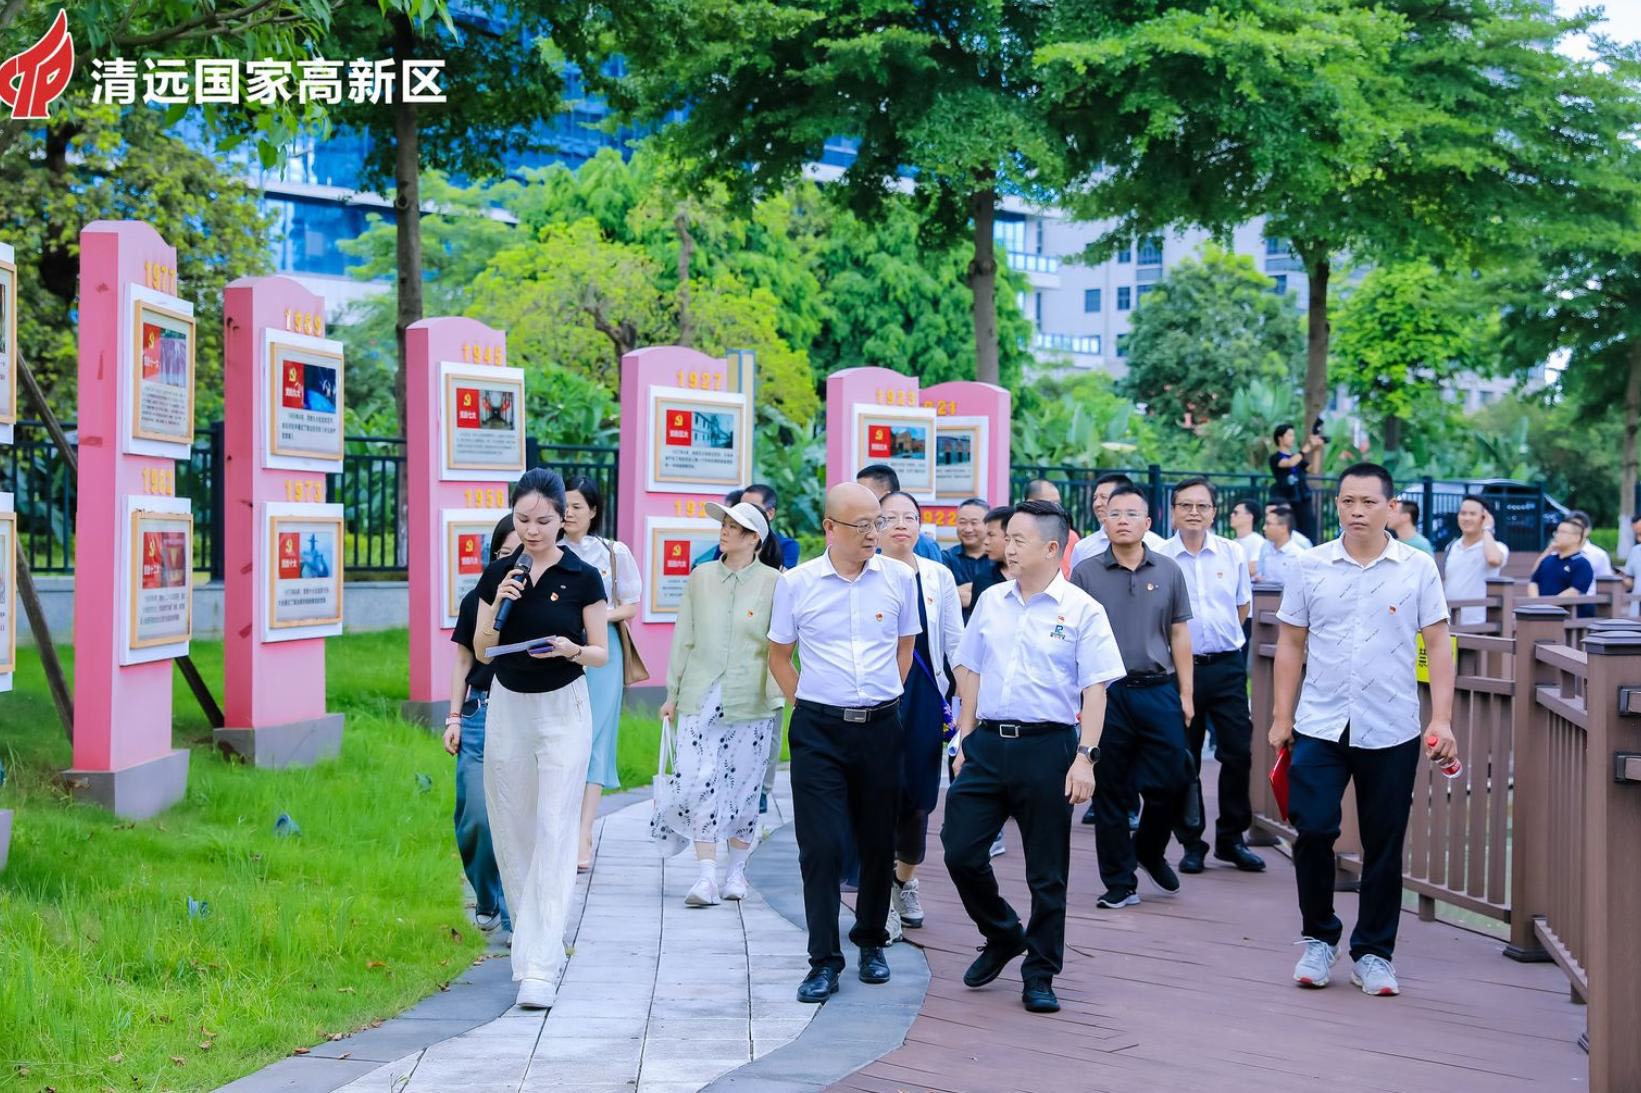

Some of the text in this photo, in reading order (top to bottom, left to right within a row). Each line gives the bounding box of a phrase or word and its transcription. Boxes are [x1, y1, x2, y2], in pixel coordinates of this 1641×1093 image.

[145, 260, 175, 296] 1977
[462, 343, 503, 366] 1945
[676, 368, 721, 391] 1927
[465, 488, 504, 509] 1956
